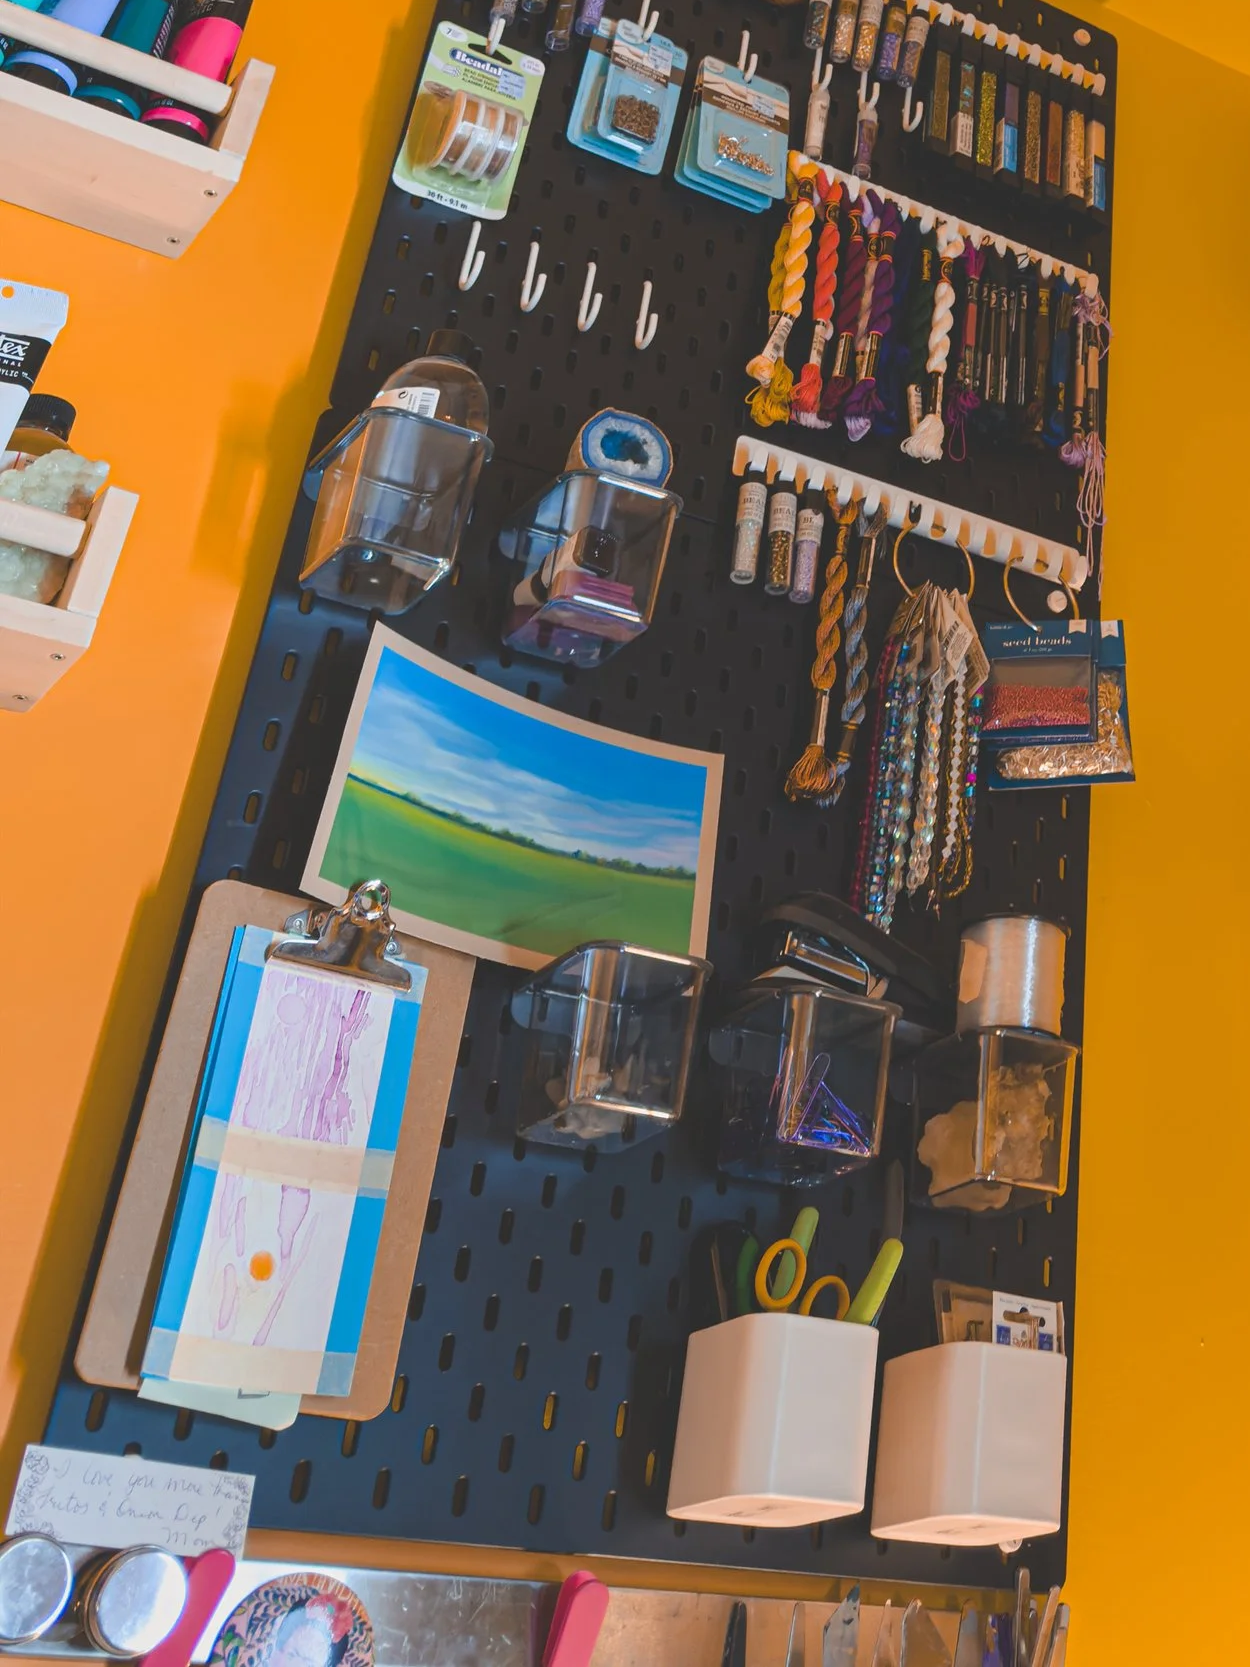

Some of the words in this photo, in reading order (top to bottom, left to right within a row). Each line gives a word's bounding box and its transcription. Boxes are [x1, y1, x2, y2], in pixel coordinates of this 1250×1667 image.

[455, 51, 503, 75] Beadal
[437, 192, 443, 201] ft
[1002, 636, 1031, 648] seed
[1035, 635, 1072, 646] beads
[128, 1473, 154, 1496] you
[166, 1475, 203, 1495] more
[164, 1527, 217, 1547] Mom
